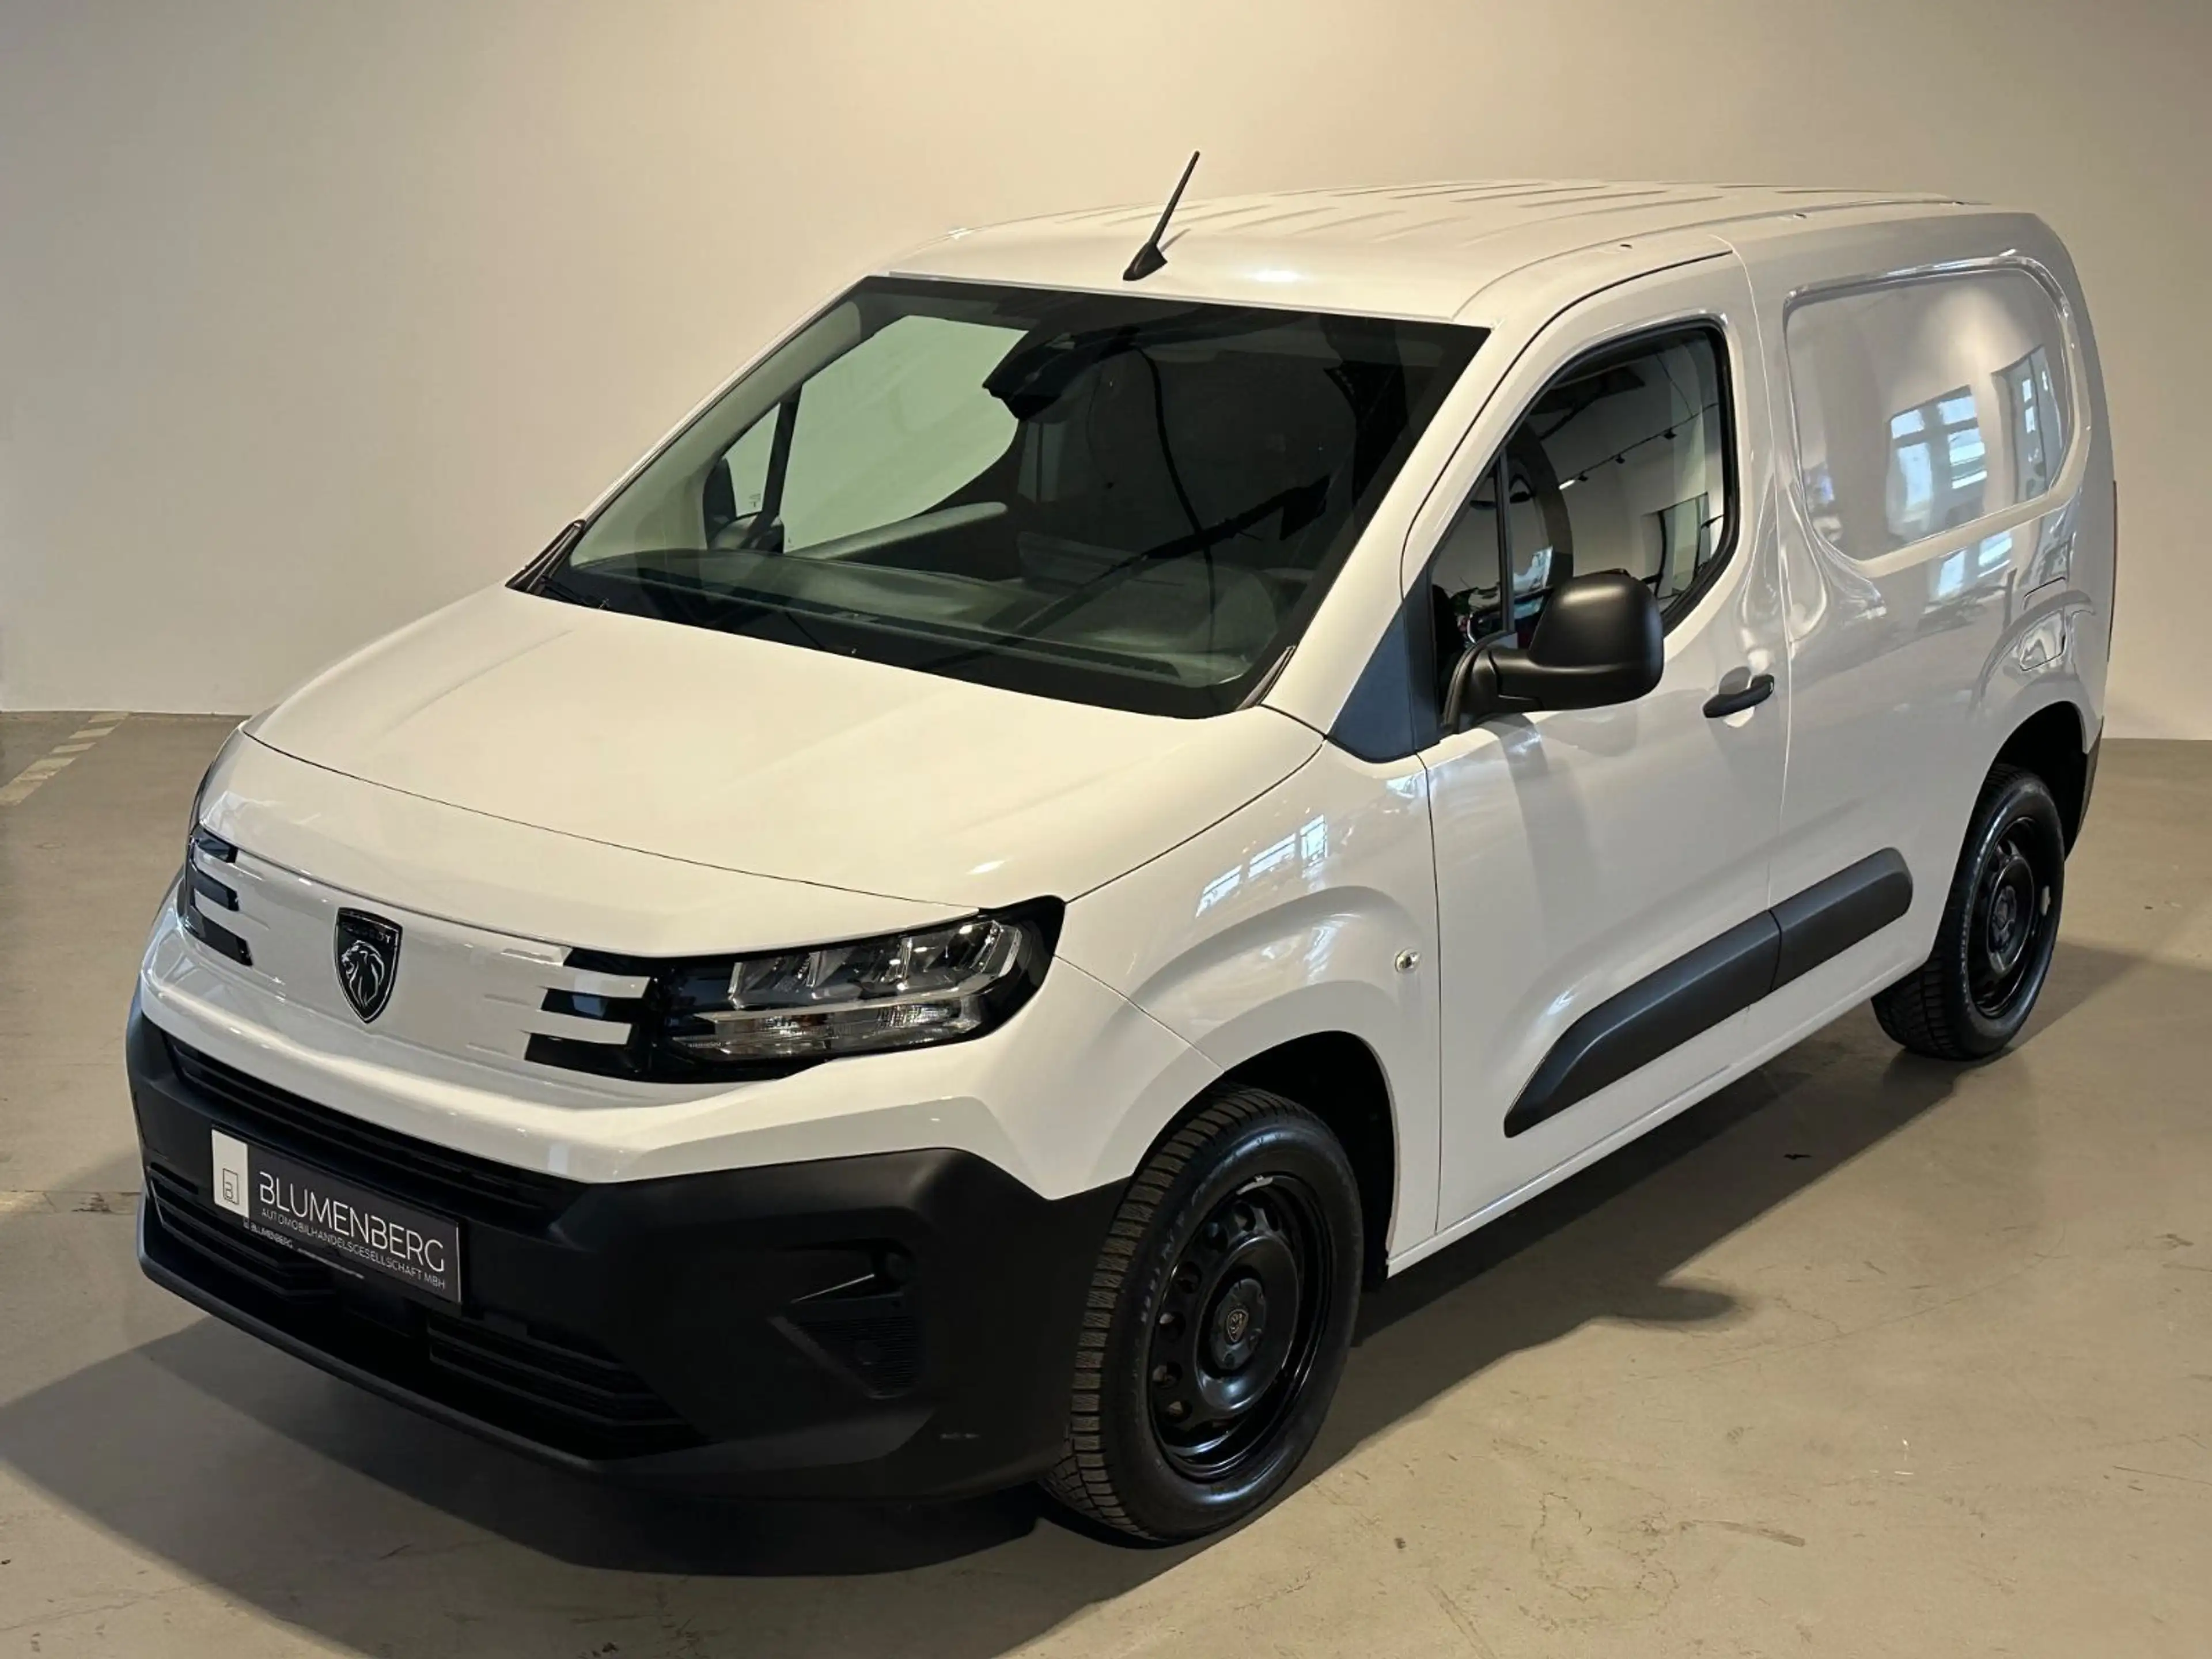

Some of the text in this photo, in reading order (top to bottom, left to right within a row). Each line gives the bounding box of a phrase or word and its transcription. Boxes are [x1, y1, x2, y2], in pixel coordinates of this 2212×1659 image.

[259, 1171, 445, 1272] BLUMENBERG
[261, 1208, 445, 1290] AUTOMOBILHANDELSGESELLSCHAFT MBH
